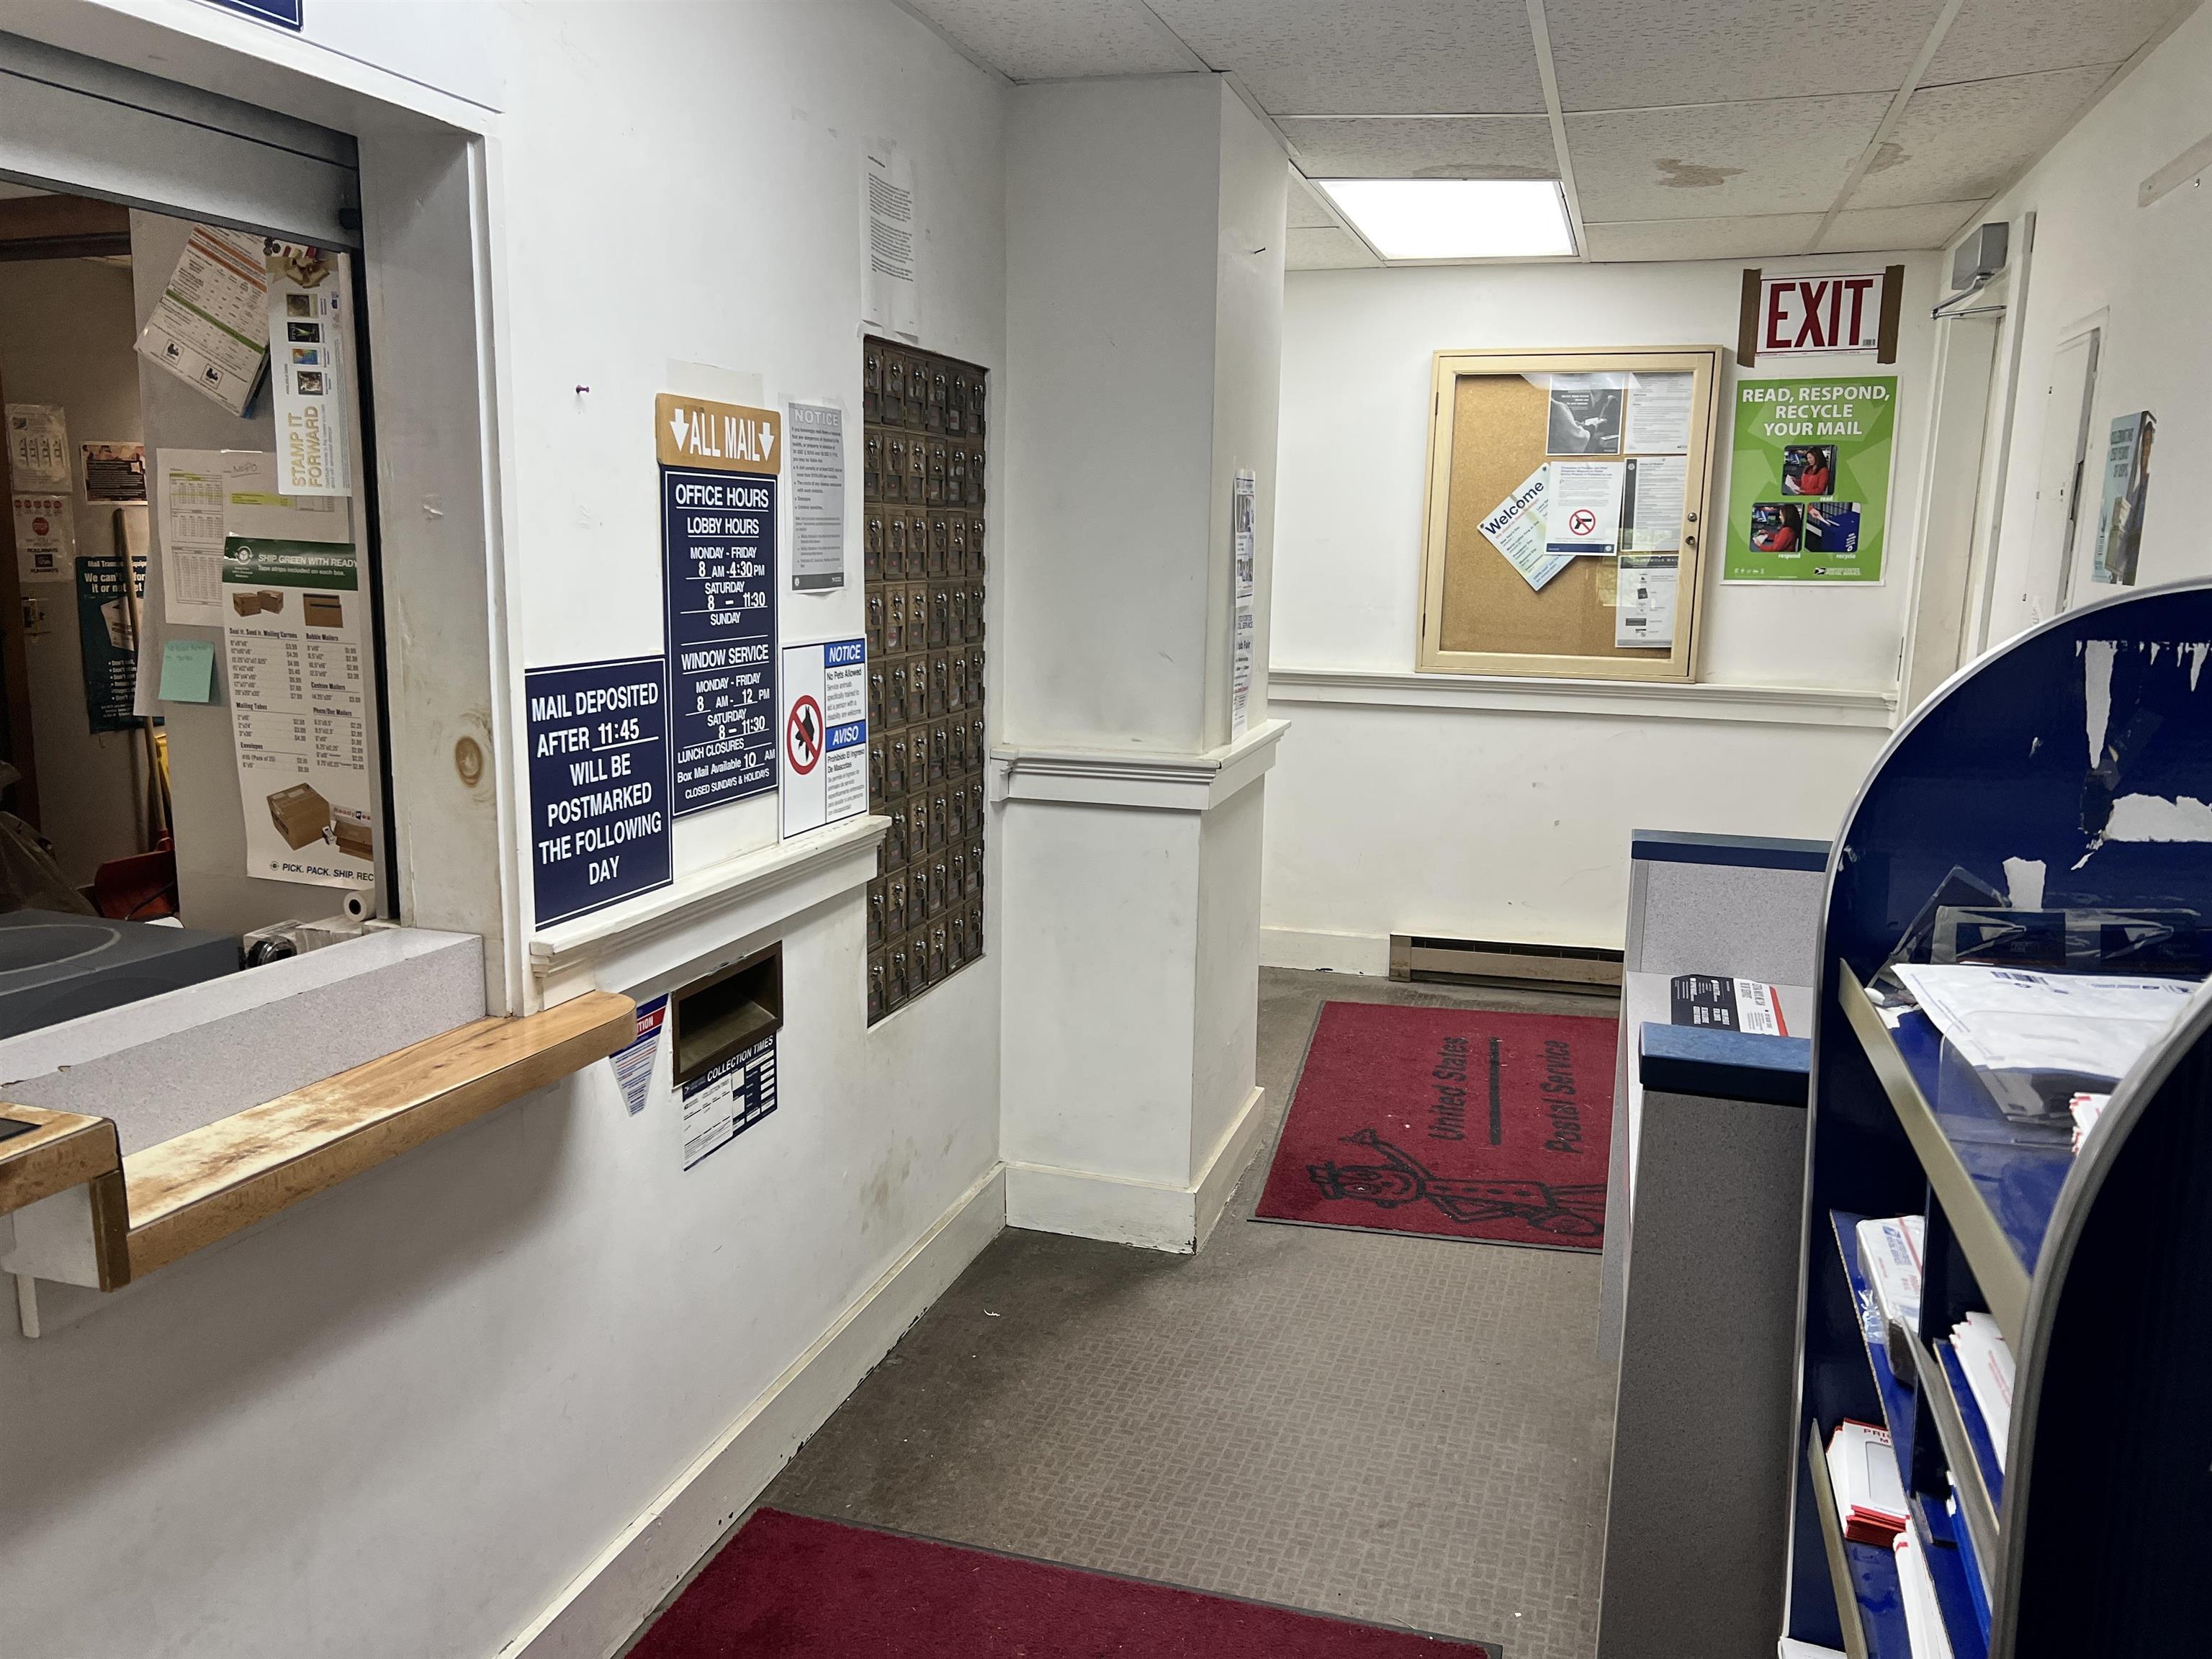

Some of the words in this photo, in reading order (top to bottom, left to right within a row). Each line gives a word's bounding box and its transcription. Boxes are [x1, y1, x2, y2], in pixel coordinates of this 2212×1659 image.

[1766, 279, 1874, 349] EXIT
[1742, 387, 1794, 403] READ,
[1799, 385, 1890, 401] RESPOND,
[288, 413, 302, 427] IT
[794, 409, 838, 426] NOTICE
[1775, 404, 1853, 418] RECYCLE
[689, 410, 721, 457] ALL
[724, 415, 760, 462] MAIL
[1763, 423, 1813, 436] YOUR
[1817, 421, 1862, 436] MAIL
[305, 405, 323, 488] FORWARD
[290, 432, 306, 487] STAMP
[675, 483, 723, 506] OFFICE
[727, 487, 769, 508] HOURS
[1485, 482, 1544, 534] Welcome
[687, 517, 723, 534] LOBBY
[725, 518, 760, 534] HOURS
[258, 554, 277, 563] SHIP
[278, 555, 307, 565] GREEN
[307, 557, 330, 566] WITH
[690, 547, 724, 559] MONDAY
[731, 547, 757, 559] FRIDAY
[84, 572, 98, 583] We
[698, 561, 706, 577] 8
[711, 565, 724, 577] AM
[729, 561, 753, 577] 4:30
[753, 565, 765, 576] PM
[91, 584, 99, 593] it
[134, 583, 143, 592] et
[704, 581, 745, 595] SATURDAY
[708, 595, 715, 611] 8
[743, 592, 766, 608] 11:30
[710, 612, 741, 626] SUNDAY
[264, 630, 280, 639] Mailing
[681, 649, 726, 670] WINDOW
[728, 644, 769, 665] SERVICE
[829, 644, 862, 662] NOTICE
[696, 678, 729, 693] MONDAY
[736, 673, 761, 687] FRIDAY
[827, 672, 833, 680] No
[834, 671, 844, 680] Pets
[845, 667, 862, 678] Allowed
[236, 702, 253, 711] Mailing
[531, 694, 572, 722] MAIL
[575, 682, 658, 716] DEPOSITED
[696, 696, 704, 712] 8
[715, 695, 729, 709] AM
[742, 688, 753, 703] 12
[758, 688, 770, 701] PM
[707, 709, 747, 727] SATURDAY
[719, 724, 726, 739] 8
[742, 715, 765, 734] 11:30
[536, 727, 590, 758] AFTER
[597, 717, 639, 745] 11:45
[832, 725, 859, 746] AVISO
[678, 747, 704, 764] LUNCH
[706, 737, 745, 757] CLOSURES
[827, 752, 846, 763] Prohibido
[569, 758, 608, 787] WILL
[611, 752, 631, 778] BE
[677, 771, 692, 783] Box
[693, 765, 709, 779] Mail
[711, 757, 742, 775] Available
[743, 752, 757, 768] 10
[764, 748, 775, 761] AM
[685, 784, 711, 799] CLOSED
[711, 777, 737, 792] SUNDAYS
[738, 775, 743, 784] &
[743, 768, 770, 783] HOLIDAYS
[547, 781, 652, 827] POSTMARKED
[538, 835, 572, 865] THE
[575, 811, 662, 855] FOLLOWING
[282, 863, 305, 873] PICK.
[306, 866, 331, 876] PACK.
[333, 869, 354, 879] SHIP.
[356, 872, 374, 881] REC
[588, 855, 620, 886] DAY
[707, 1046, 752, 1082] COLLECTION
[753, 1035, 773, 1055] TIMES
[1431, 1036, 1467, 1082] States
[1536, 1040, 1576, 1095] Service
[1428, 1084, 1467, 1141] United
[1542, 1097, 1583, 1154] Postal
[1863, 1429, 1891, 1439] PRI
